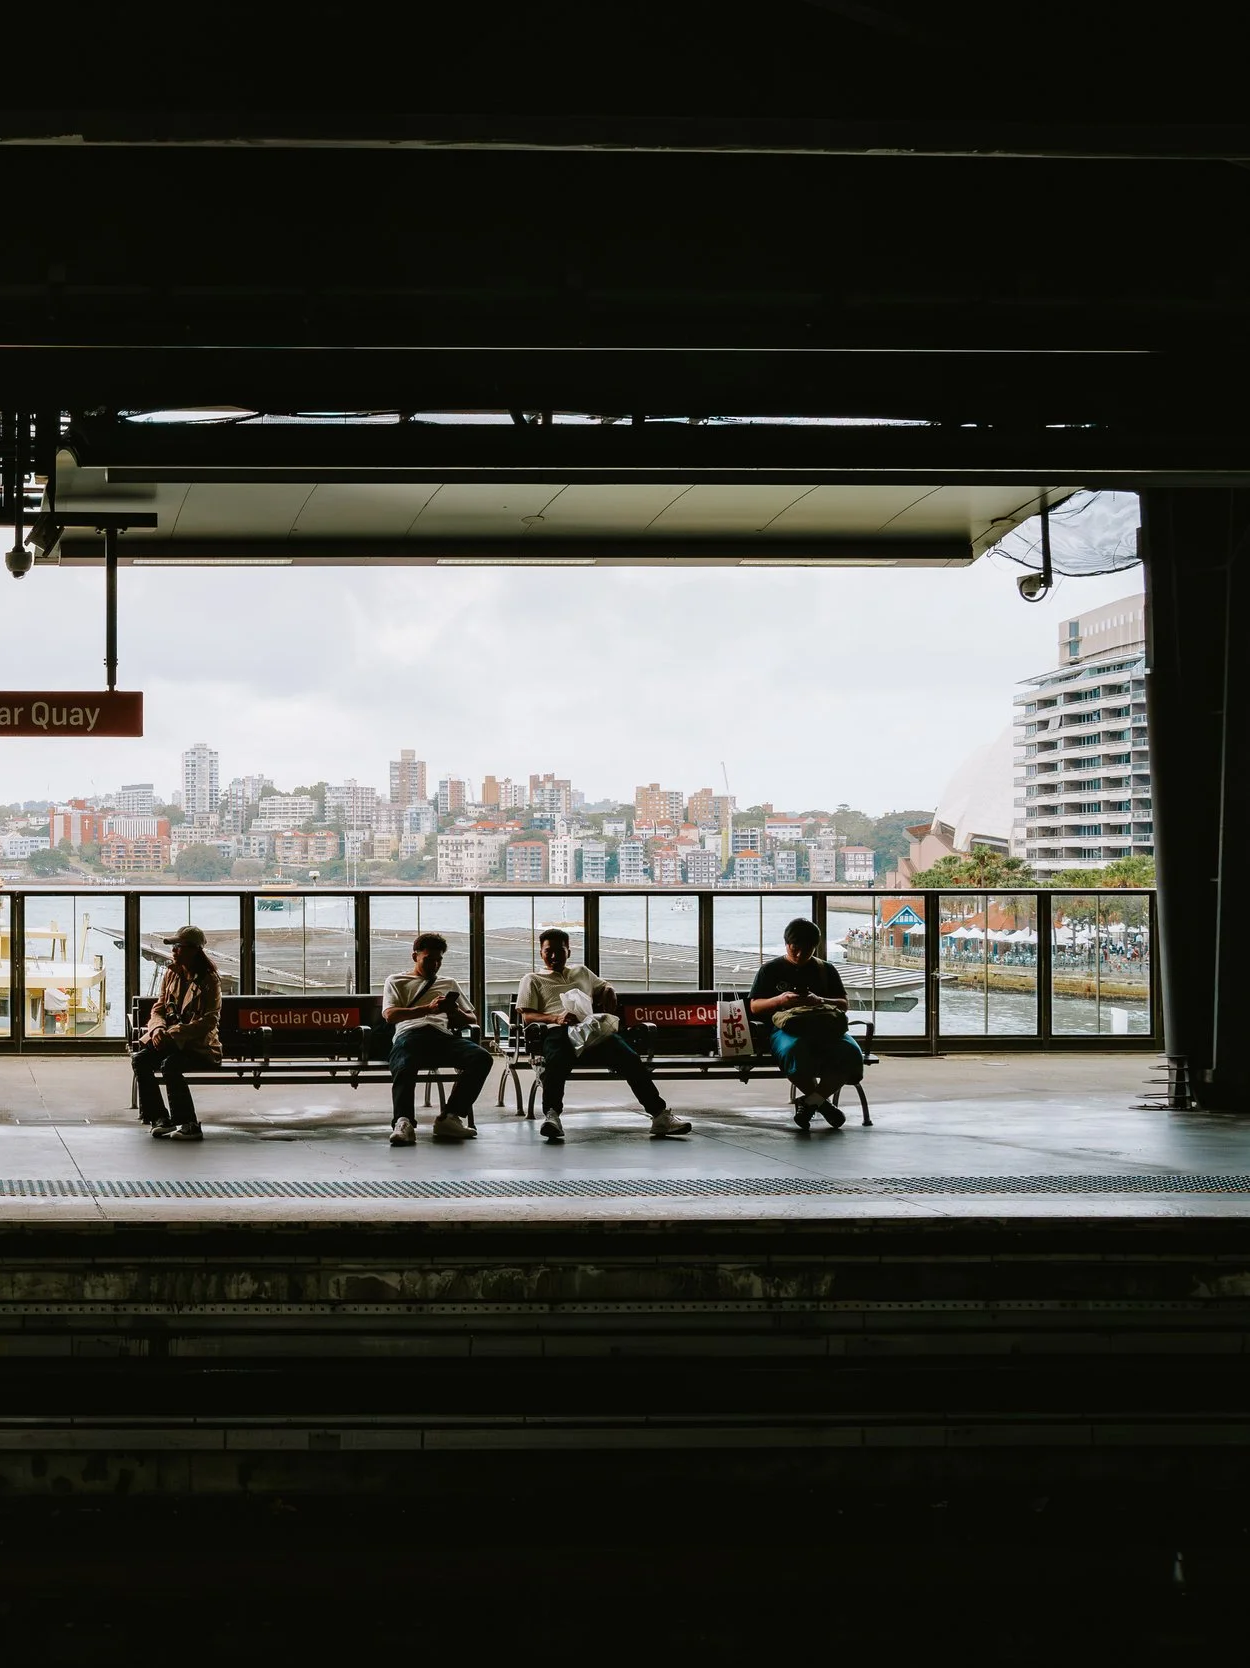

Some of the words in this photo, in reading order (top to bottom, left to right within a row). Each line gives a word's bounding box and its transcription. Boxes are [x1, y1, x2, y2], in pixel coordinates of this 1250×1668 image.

[31, 701, 100, 732] Quay
[250, 1010, 308, 1025] Circular
[311, 1010, 350, 1027] Quay
[634, 1007, 693, 1021] Circular
[696, 1006, 718, 1022] Qu
